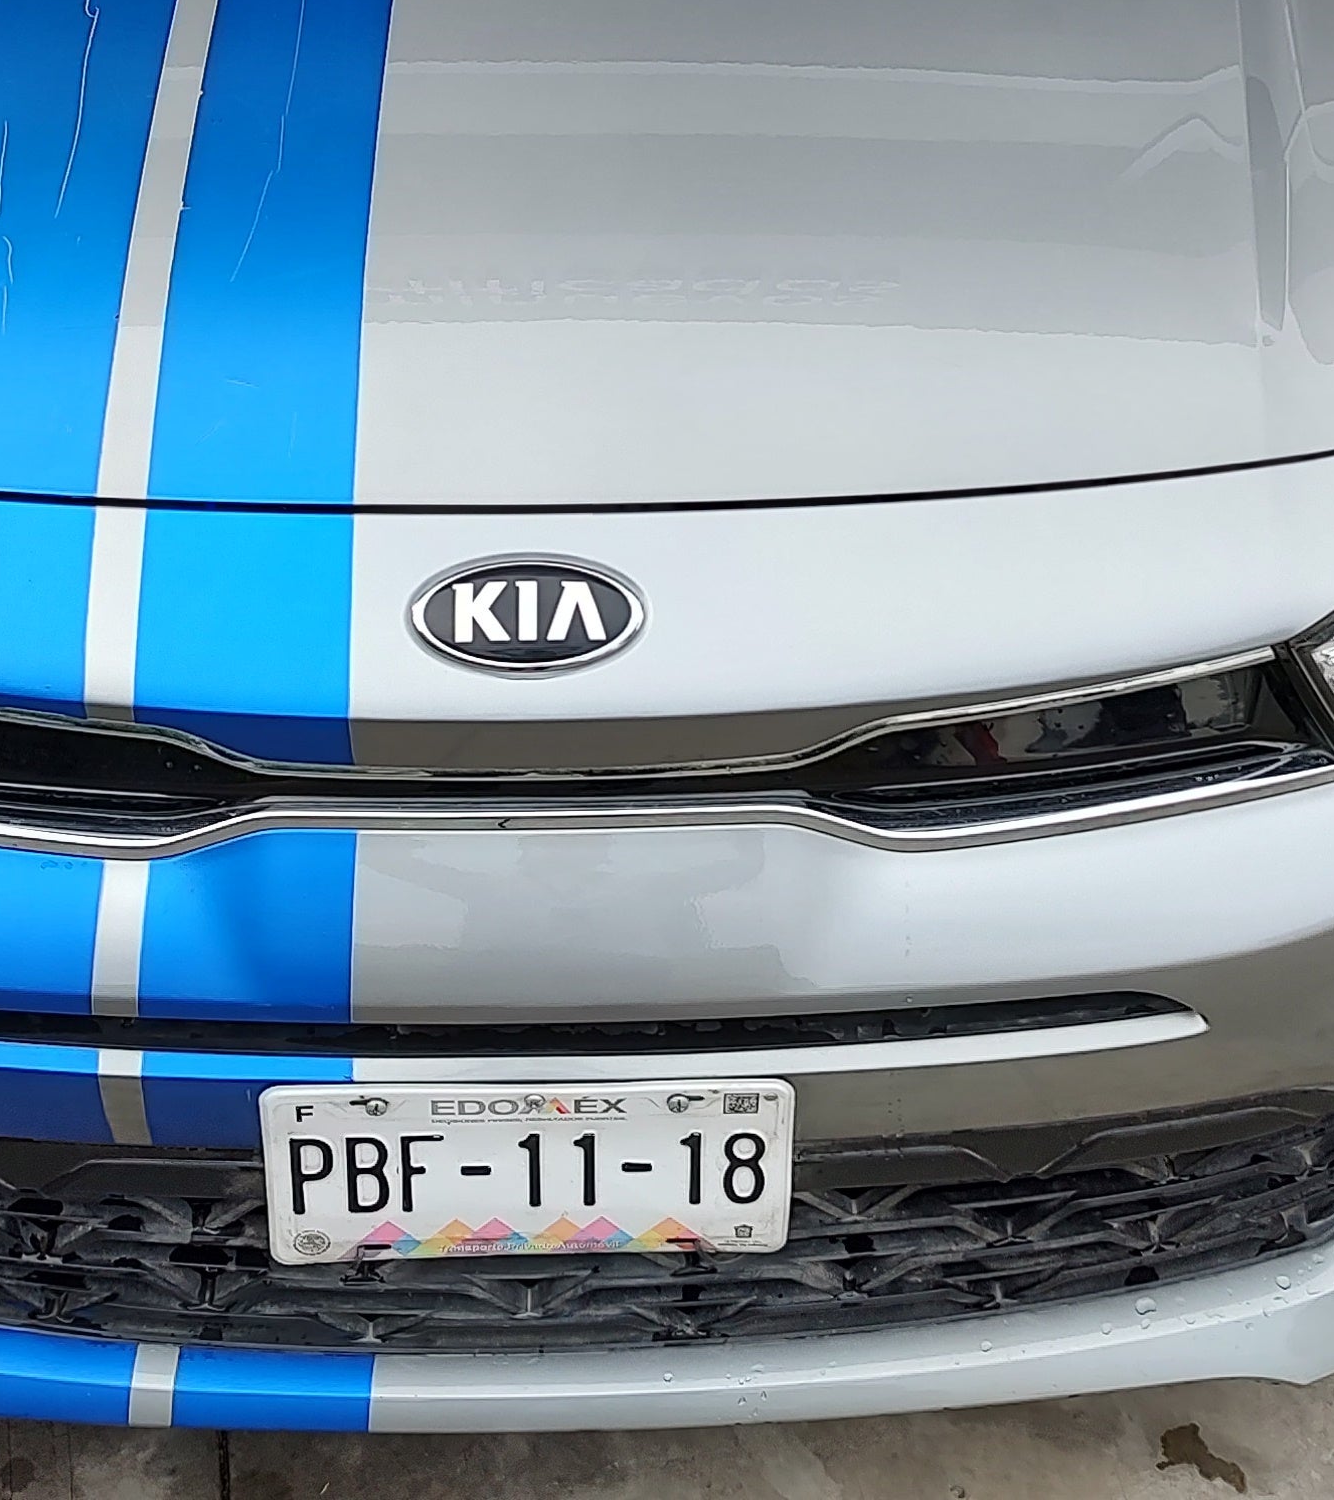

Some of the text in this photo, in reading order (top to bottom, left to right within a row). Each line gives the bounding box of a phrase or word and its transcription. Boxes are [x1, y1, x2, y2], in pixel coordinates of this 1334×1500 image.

[451, 580, 606, 643] KIA
[295, 1105, 314, 1123] F
[289, 1132, 765, 1215] PBF-11-18
